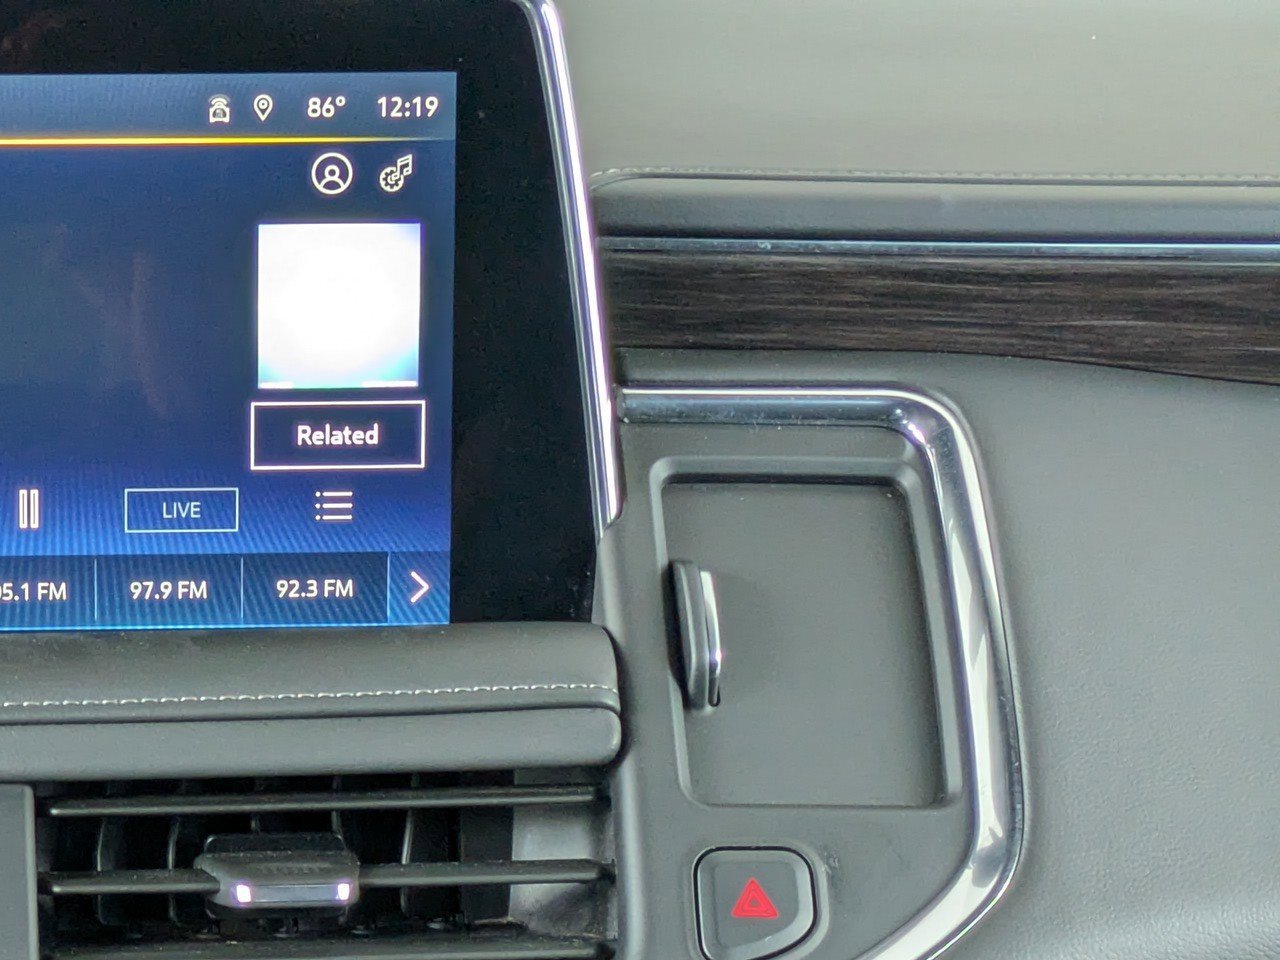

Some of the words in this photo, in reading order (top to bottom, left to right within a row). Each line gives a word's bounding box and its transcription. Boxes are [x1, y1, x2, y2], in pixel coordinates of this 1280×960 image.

[377, 96, 439, 118] 12:19
[297, 424, 379, 446] Related
[162, 502, 201, 518] LIVE
[37, 582, 67, 601] FM
[130, 581, 172, 600] 97.9
[178, 580, 208, 599] FM
[276, 579, 318, 598] 92.3
[324, 579, 354, 598] FM
